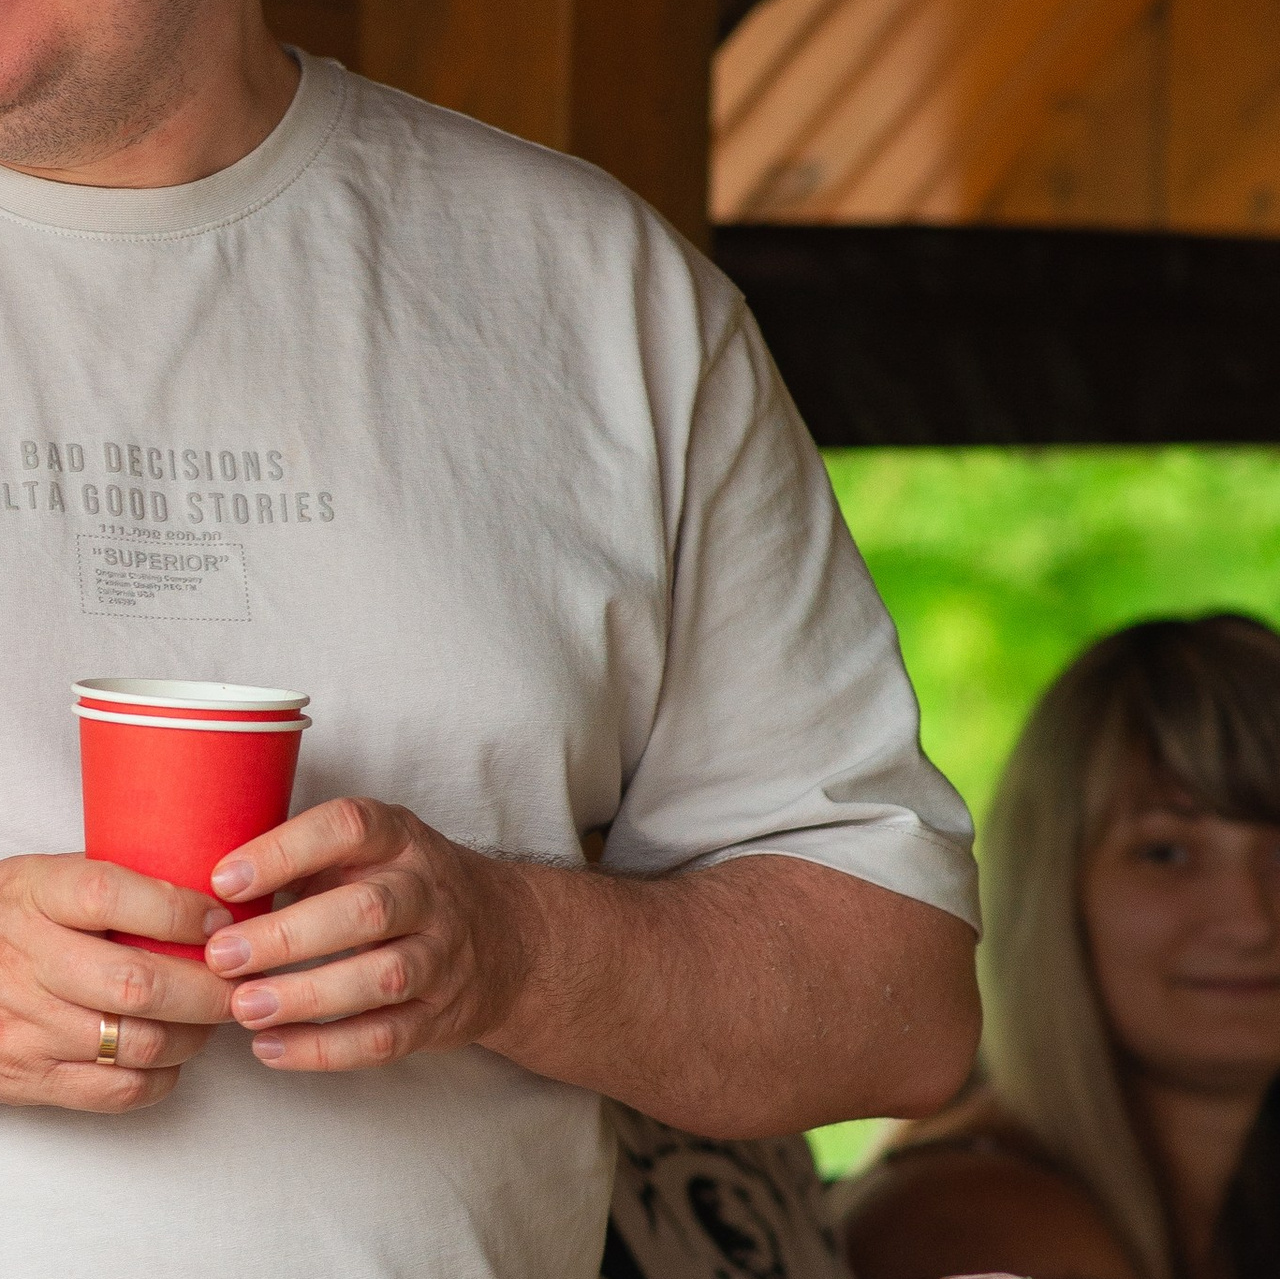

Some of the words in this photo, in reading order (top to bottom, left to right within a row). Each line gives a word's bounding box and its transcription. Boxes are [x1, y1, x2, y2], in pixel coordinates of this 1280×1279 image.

[20, 439, 85, 473] BAD
[104, 441, 285, 482] DECISIONS
[81, 484, 169, 523] GOOD
[186, 491, 336, 524] STORIES
